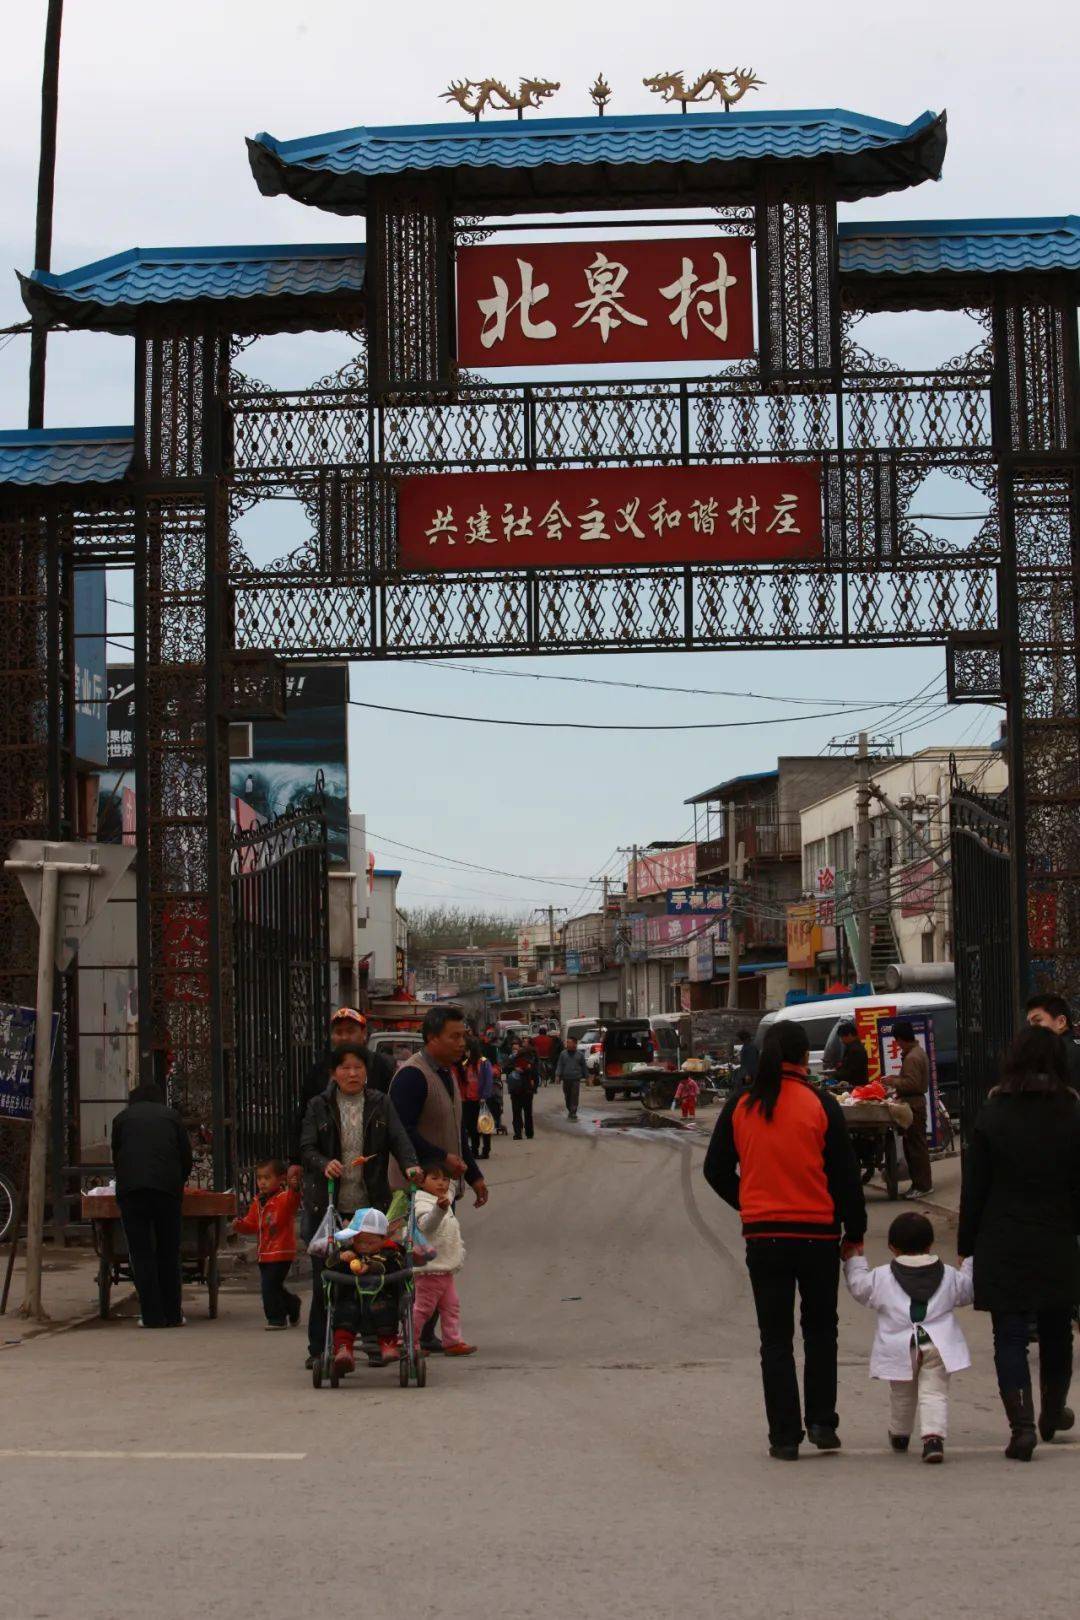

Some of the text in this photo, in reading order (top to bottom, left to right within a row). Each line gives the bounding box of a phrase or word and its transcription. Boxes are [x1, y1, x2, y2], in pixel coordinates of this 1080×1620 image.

[476, 251, 738, 350] 北皋村
[423, 492, 802, 546] 共建社会主义和谐村庄
